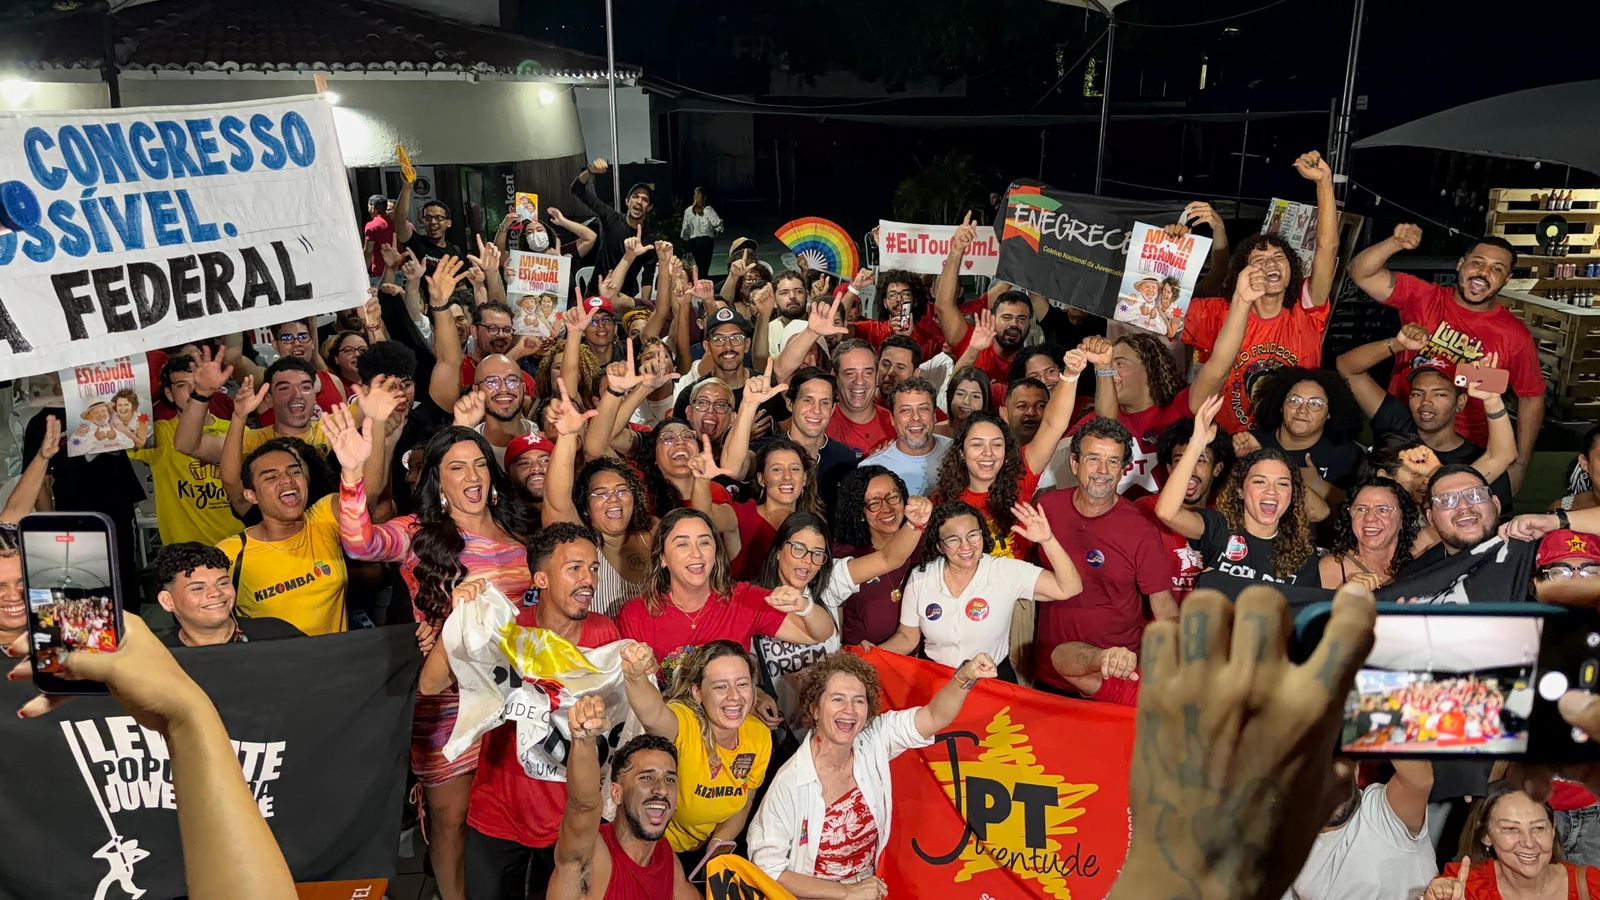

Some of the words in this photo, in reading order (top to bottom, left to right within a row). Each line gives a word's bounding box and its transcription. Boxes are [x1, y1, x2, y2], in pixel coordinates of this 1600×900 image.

[24, 111, 316, 190] CONGRESSO
[886, 232, 997, 256] #EuTouomL
[1063, 252, 1088, 265] Nacional
[1086, 260, 1095, 268] da
[94, 381, 116, 396] TODO
[1572, 541, 1584, 549] PT
[254, 573, 316, 602] KIZOMBA
[766, 646, 827, 678] ORDEM
